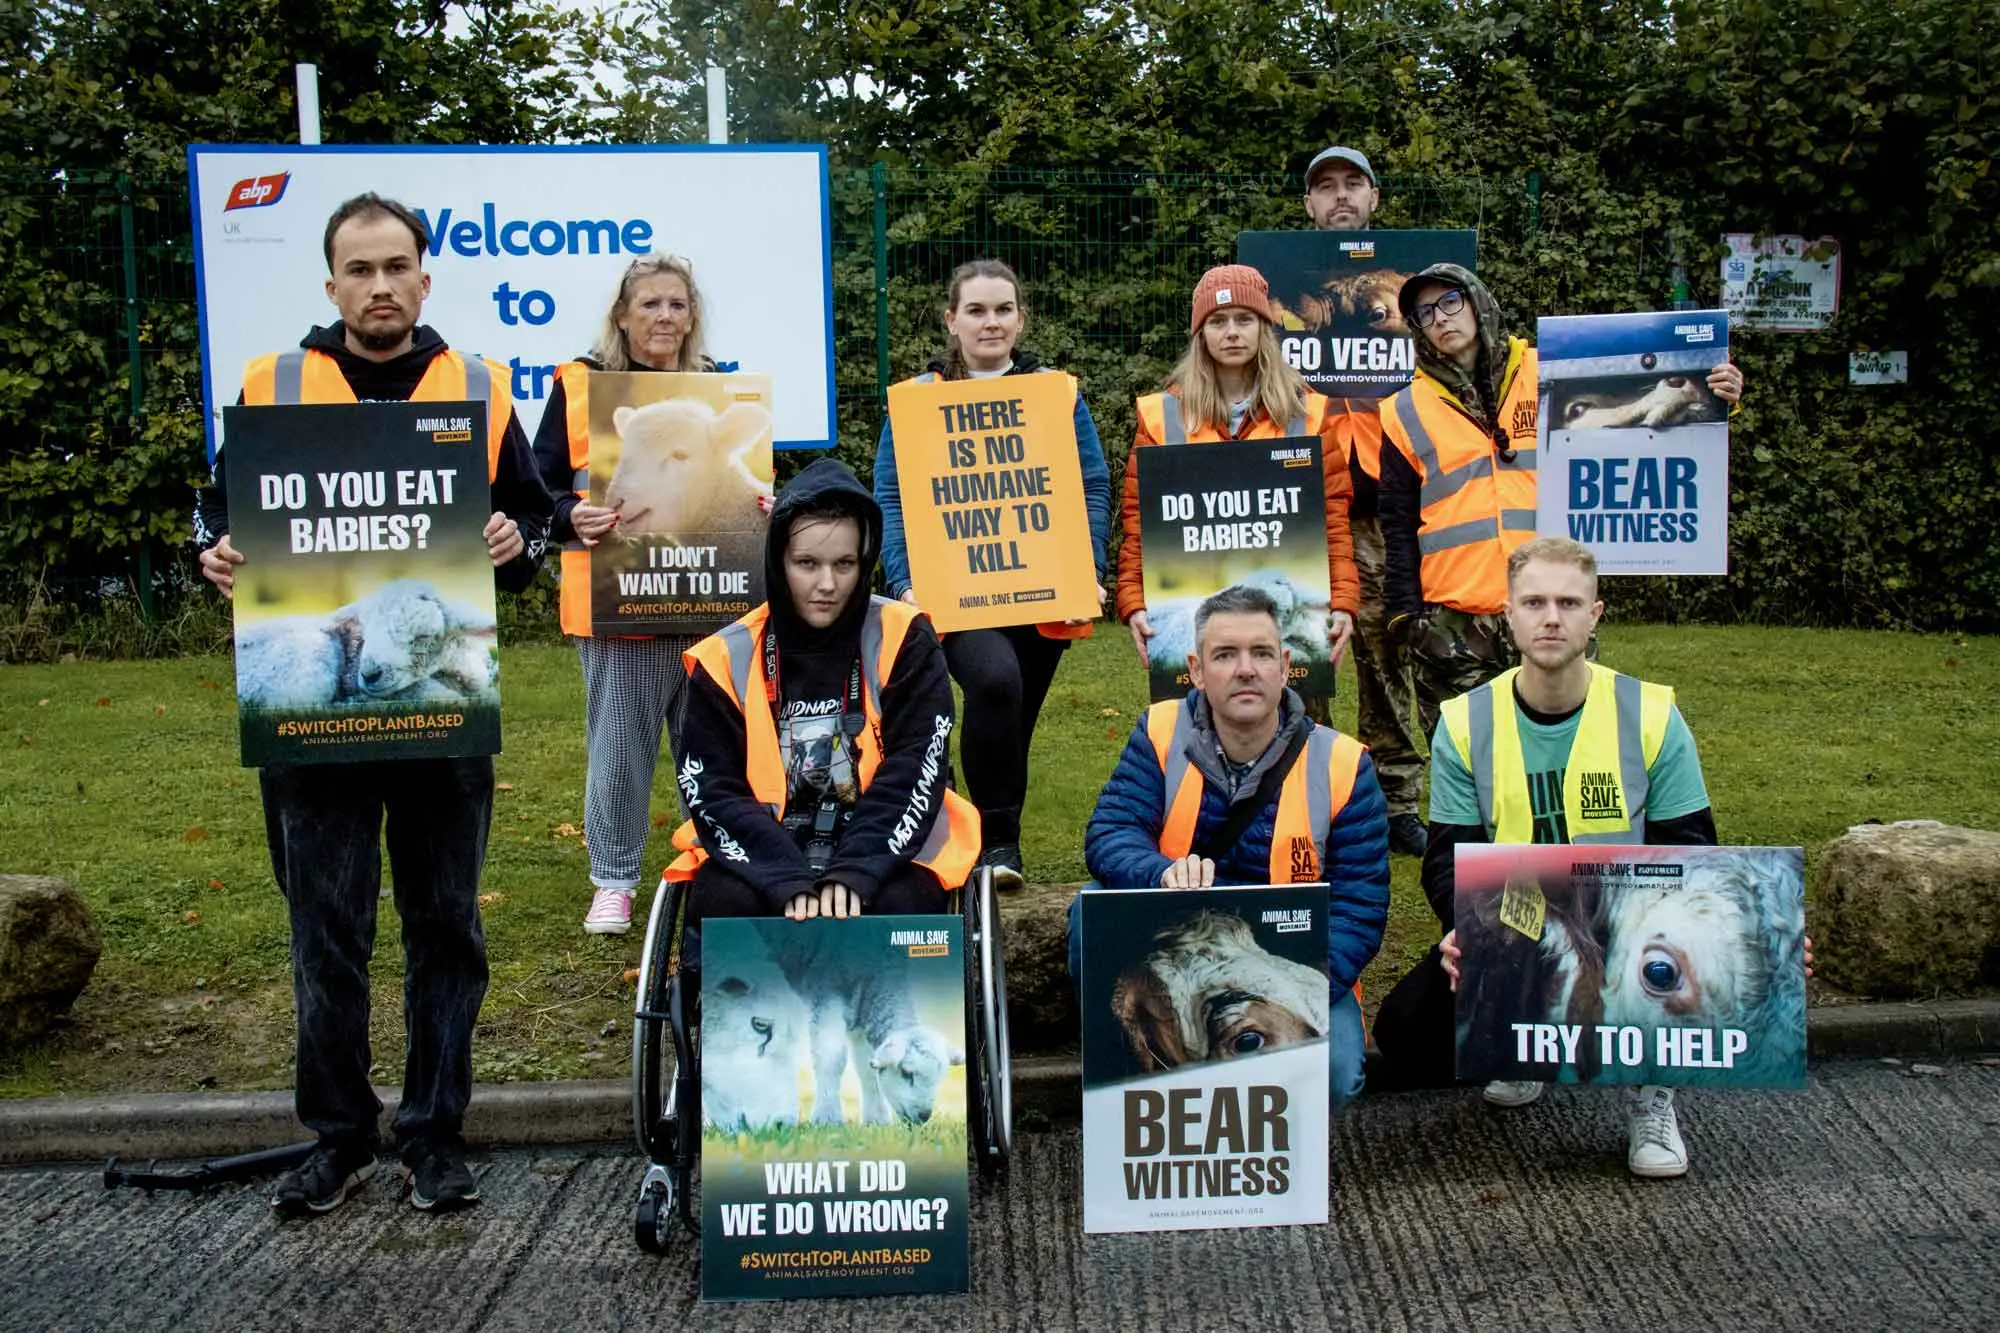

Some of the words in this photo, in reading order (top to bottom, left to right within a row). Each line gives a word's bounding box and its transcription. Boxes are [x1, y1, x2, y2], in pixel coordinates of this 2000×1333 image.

[239, 176, 272, 204] abp
[223, 222, 241, 234] UK
[415, 202, 653, 258] Welcome
[492, 282, 556, 326] to
[1281, 337, 1322, 370] GO
[416, 418, 450, 432] ANIMAL
[450, 417, 472, 431] SAVE
[939, 399, 1026, 433] THERE
[1512, 411, 1537, 430] SAV
[948, 438, 977, 468] IS
[984, 434, 1025, 464] NO
[260, 474, 307, 511] DO
[318, 471, 385, 509] YOU
[397, 469, 457, 506] EAT
[931, 467, 1052, 506] HUMANE
[1568, 457, 1699, 510] BEAR
[1162, 493, 1195, 521] DO
[1201, 490, 1251, 519] YOU
[1258, 487, 1301, 515] EAT
[290, 513, 432, 555] BABIES?
[942, 506, 1001, 541] WAY
[1012, 502, 1050, 533] TO
[1183, 520, 1284, 553] BABIES?
[1567, 512, 1699, 544] WITNESS
[649, 547, 655, 568] I
[661, 546, 718, 568] DON'T
[967, 541, 1027, 574] KILL
[618, 572, 680, 596] WANT
[687, 572, 712, 595] TO
[719, 571, 749, 595] DIE
[618, 602, 750, 615] #SWITCHTOPLANTBASED
[959, 595, 989, 609] ANIMAL
[992, 593, 1012, 606] SAVE
[278, 714, 465, 737] #SWITCHTOPLANTBASED
[1581, 786, 1620, 808] SAVE
[887, 803, 923, 855] MEAT
[910, 787, 929, 812] IS
[1584, 810, 1620, 818] MOVEMENT
[1291, 851, 1313, 873] SA
[1570, 863, 1605, 876] ANIMAL
[1608, 863, 1632, 876] SAVE
[1262, 911, 1291, 923] ANIMAL
[1292, 910, 1311, 922] SAVE
[890, 930, 926, 945] ANIMAL
[926, 930, 949, 945] SAVE
[1512, 1023, 1583, 1064] TRY
[1596, 1025, 1644, 1066] TO
[1656, 1027, 1748, 1069] HELP
[1123, 1084, 1290, 1158] BEAR
[764, 1161, 850, 1195] WHAT
[860, 1160, 906, 1192] DID
[1123, 1155, 1290, 1201] WITNESS
[720, 1203, 766, 1236] WE
[775, 1202, 814, 1235] DO
[824, 1198, 949, 1234] WRONG?
[740, 1248, 932, 1269] #SWITCHTOPLANTBASED
